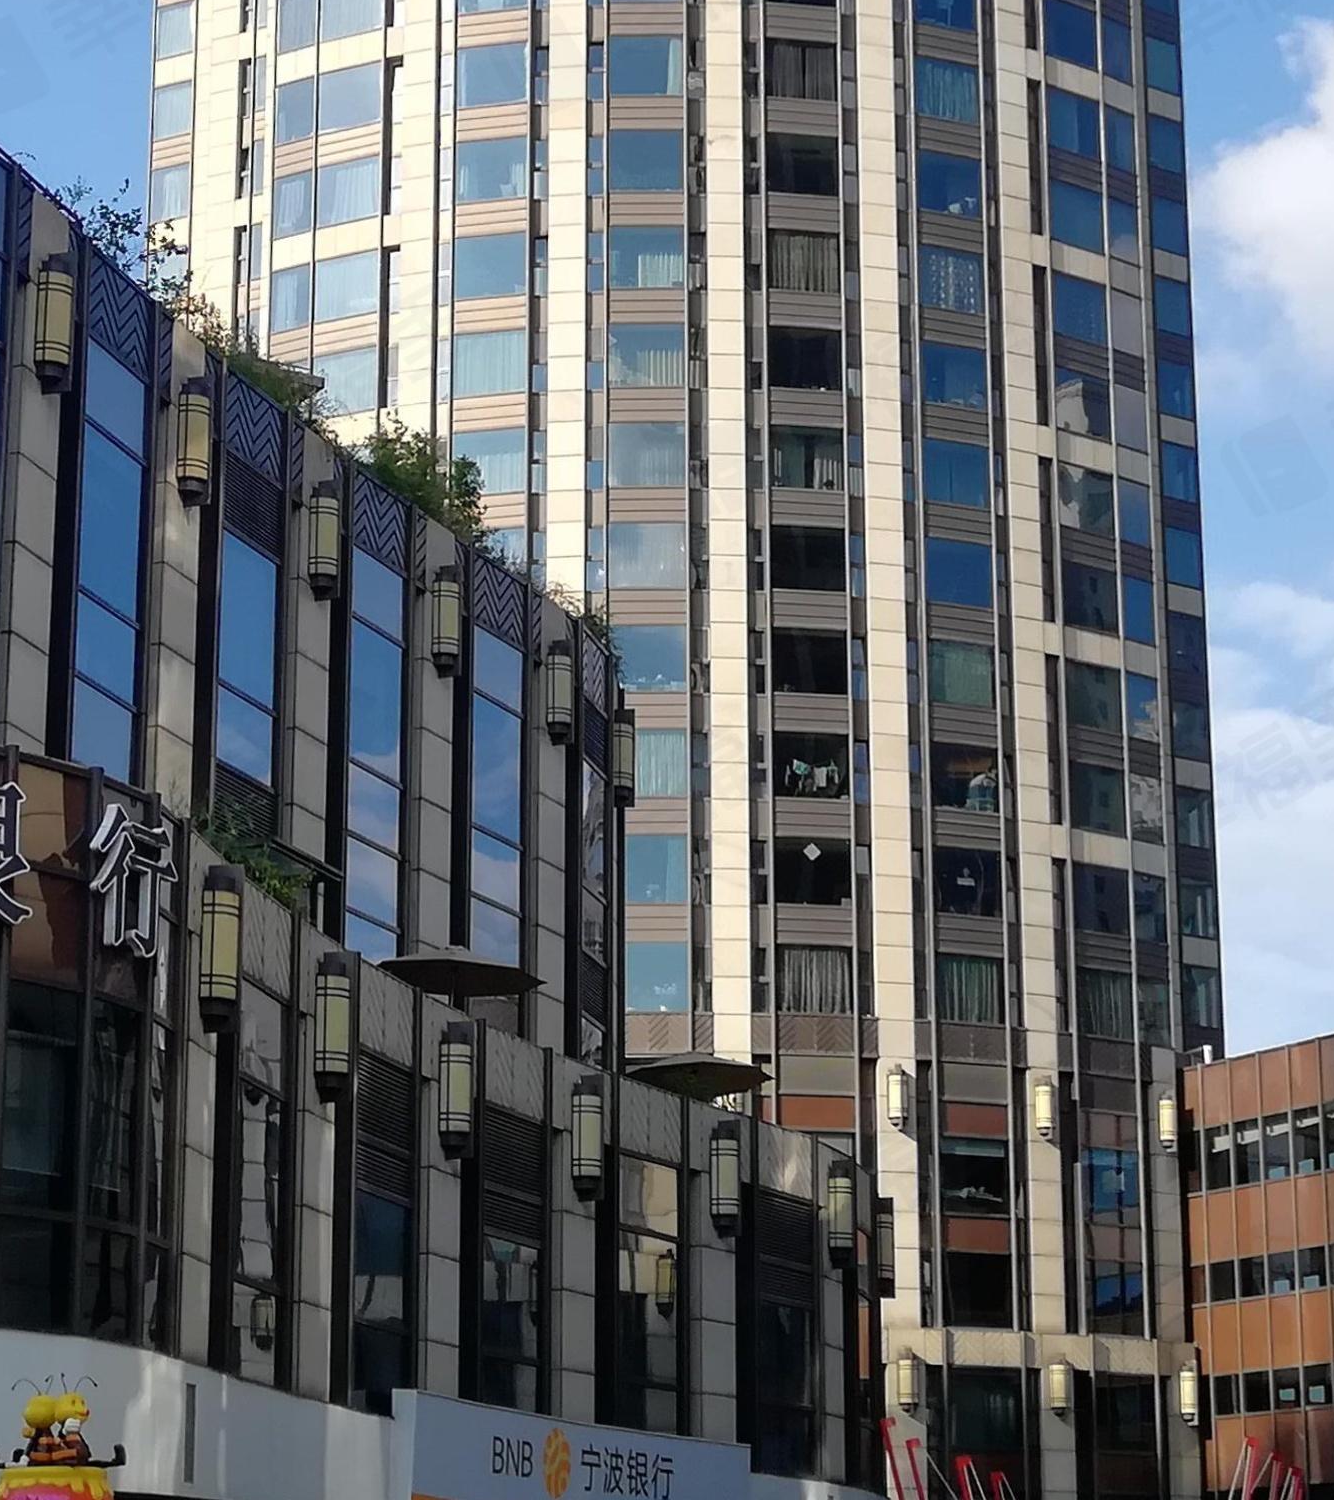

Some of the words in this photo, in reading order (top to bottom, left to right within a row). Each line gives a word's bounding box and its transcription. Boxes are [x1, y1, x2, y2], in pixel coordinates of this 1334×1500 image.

[491, 1435, 534, 1478] BNB
[580, 1442, 675, 1500] 宁波银行
